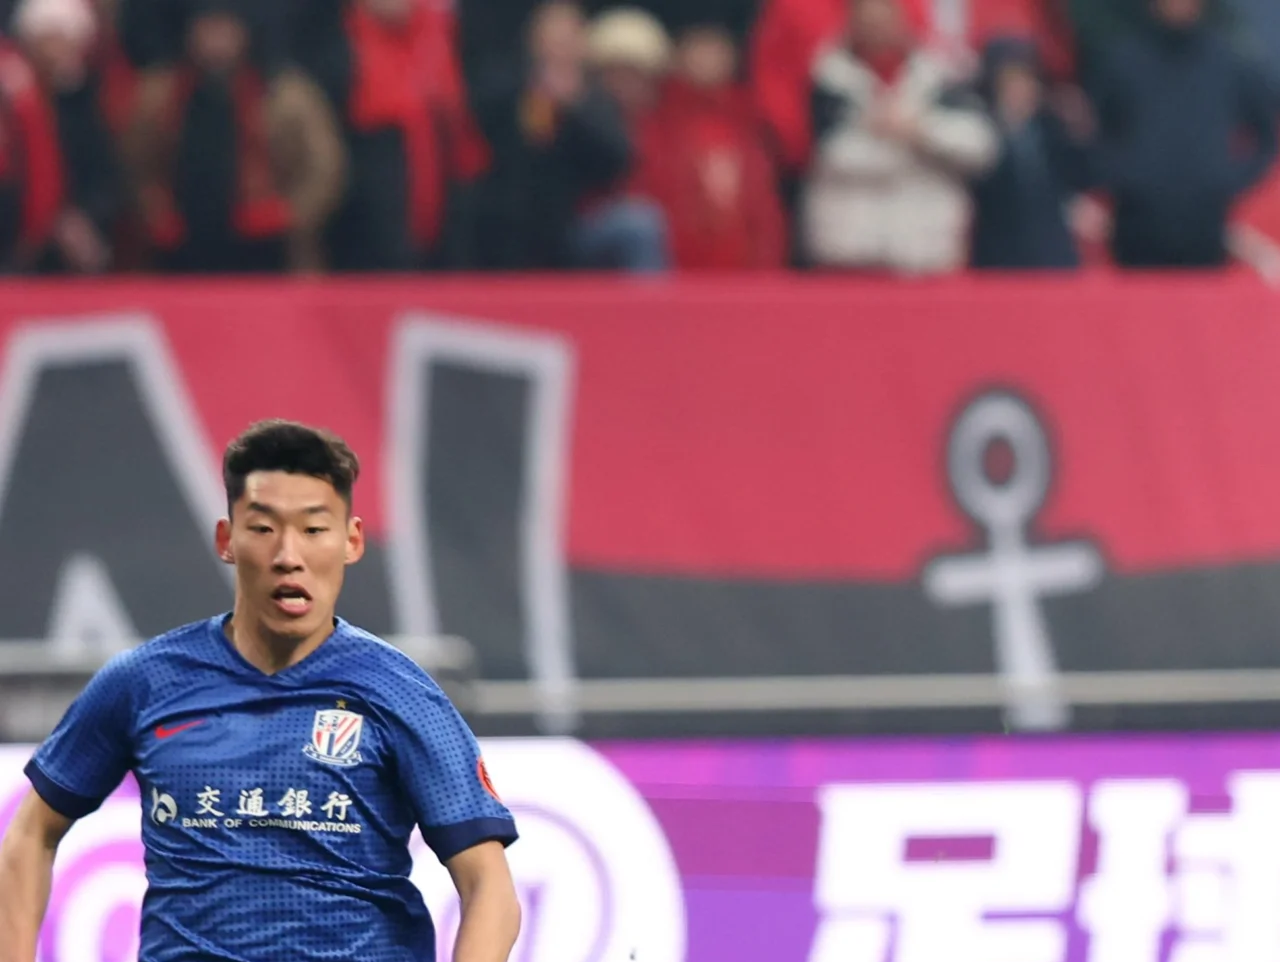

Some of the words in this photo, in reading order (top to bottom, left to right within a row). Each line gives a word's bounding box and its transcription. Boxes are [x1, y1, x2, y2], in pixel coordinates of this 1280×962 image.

[195, 785, 353, 821] 交通銀行
[182, 817, 218, 829] BANK
[223, 818, 243, 829] OF
[248, 818, 362, 834] COMMUNICATIONS
